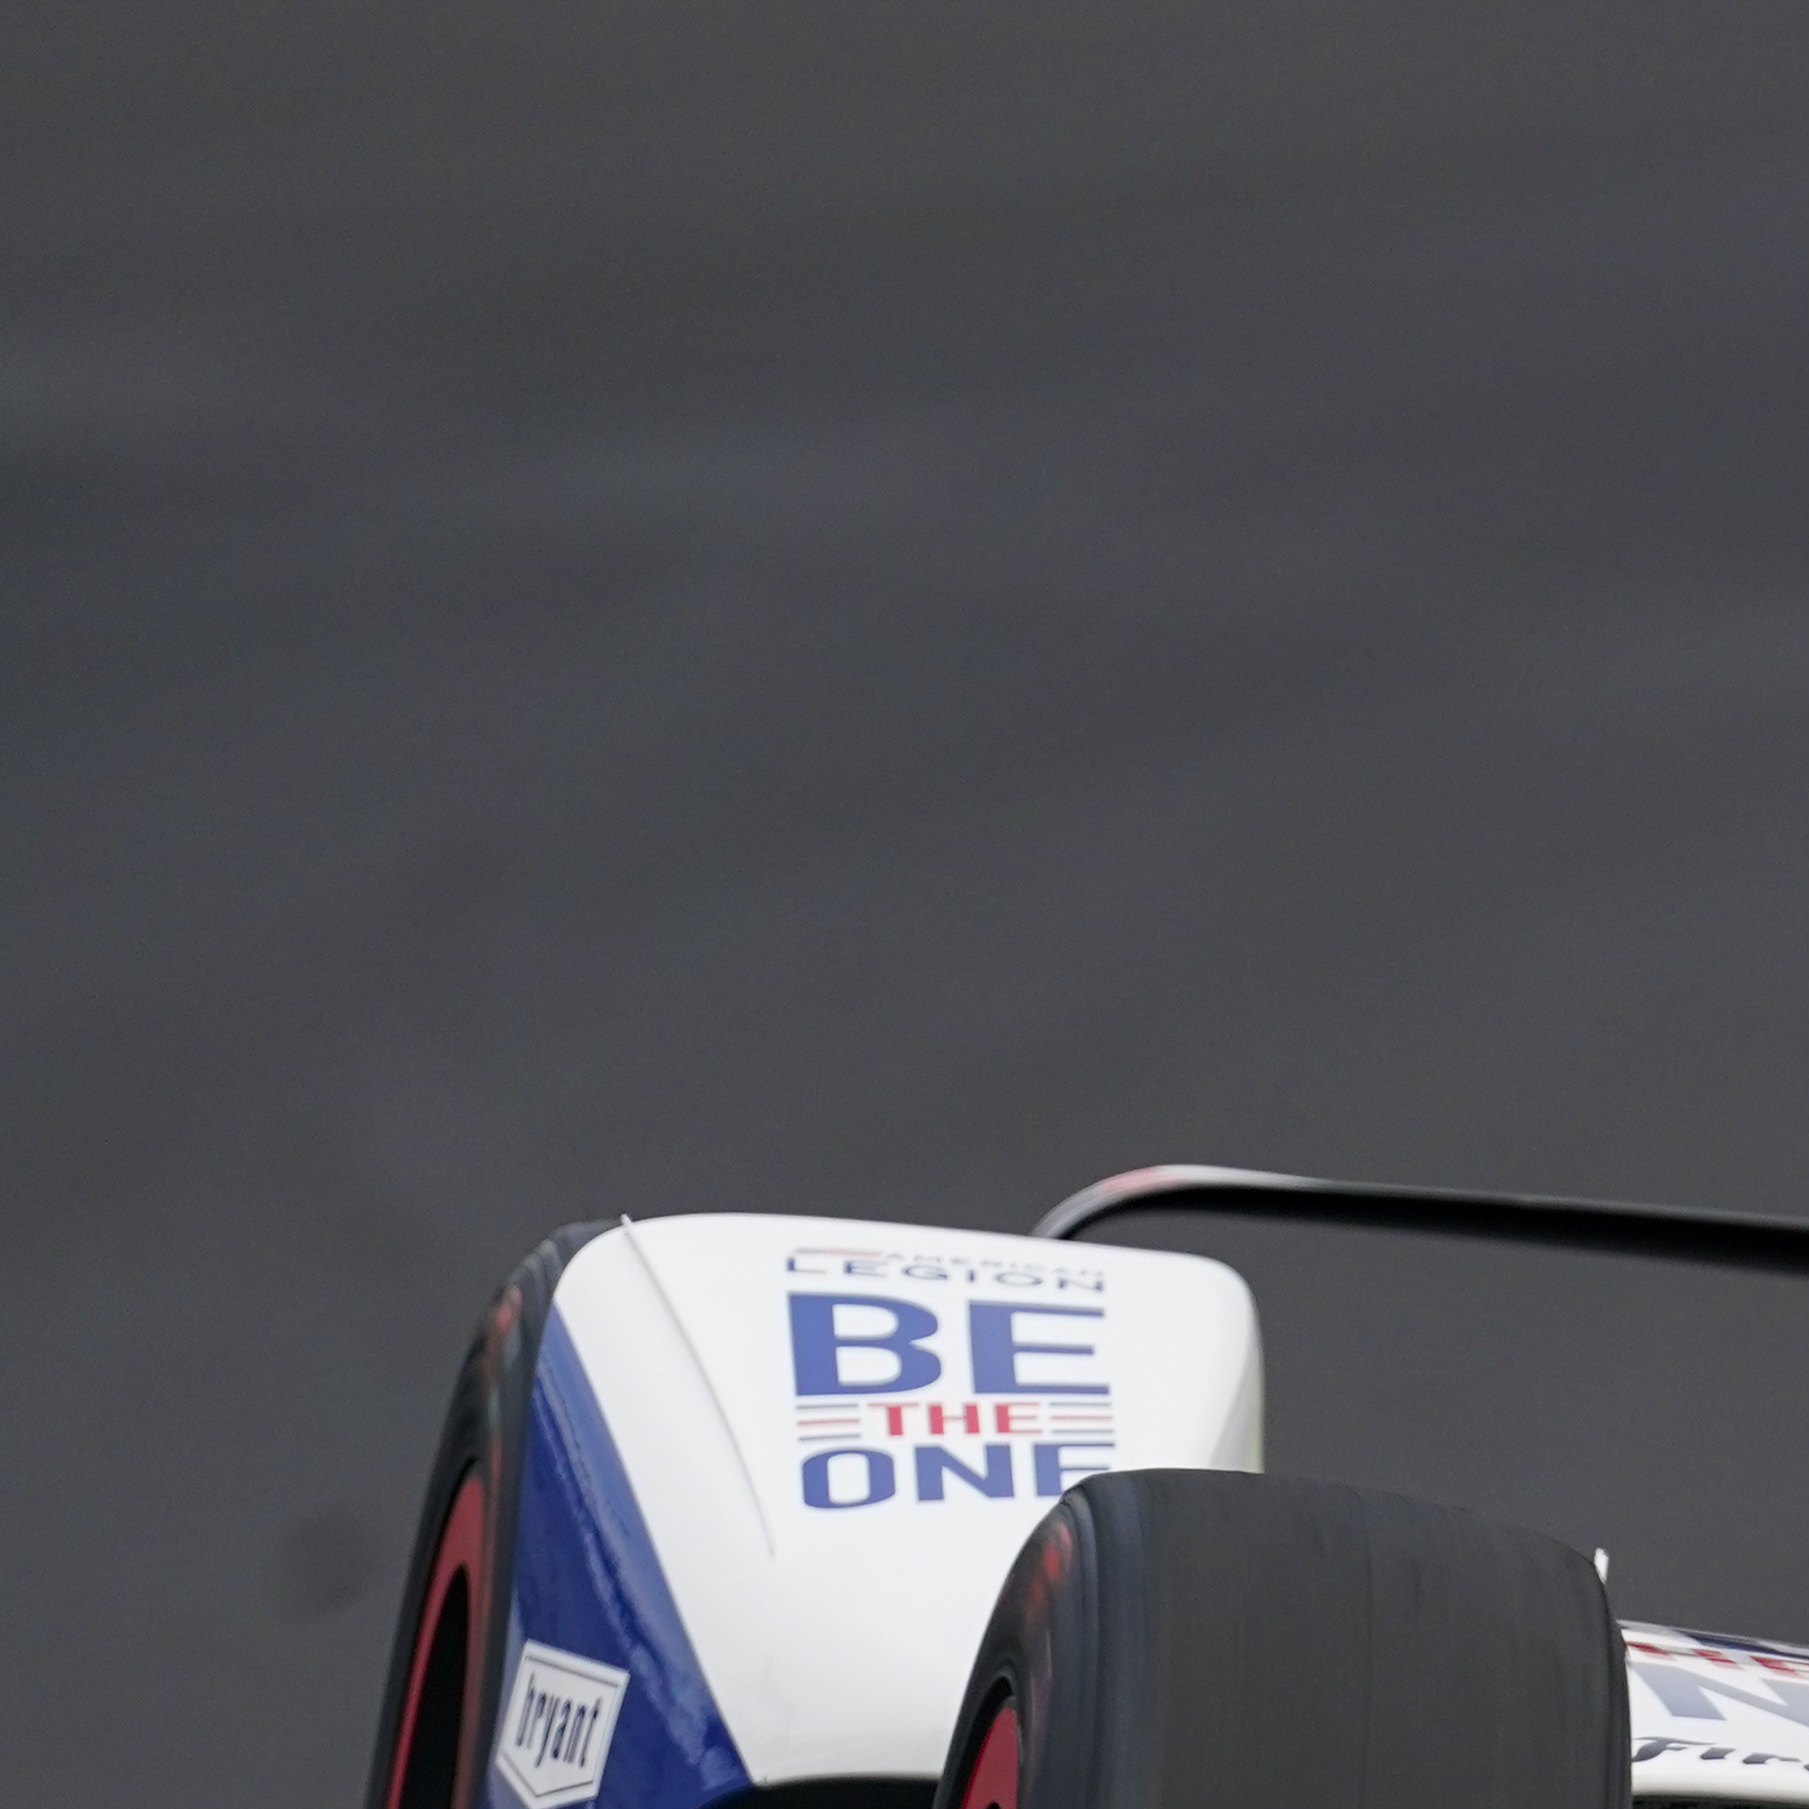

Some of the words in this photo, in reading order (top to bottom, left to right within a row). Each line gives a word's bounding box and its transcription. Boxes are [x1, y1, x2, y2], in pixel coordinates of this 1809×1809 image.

[786, 1256, 1105, 1292] LEGION
[787, 1291, 1111, 1397] BE
[867, 1402, 1043, 1436] THE
[513, 1669, 602, 1769] bryant
